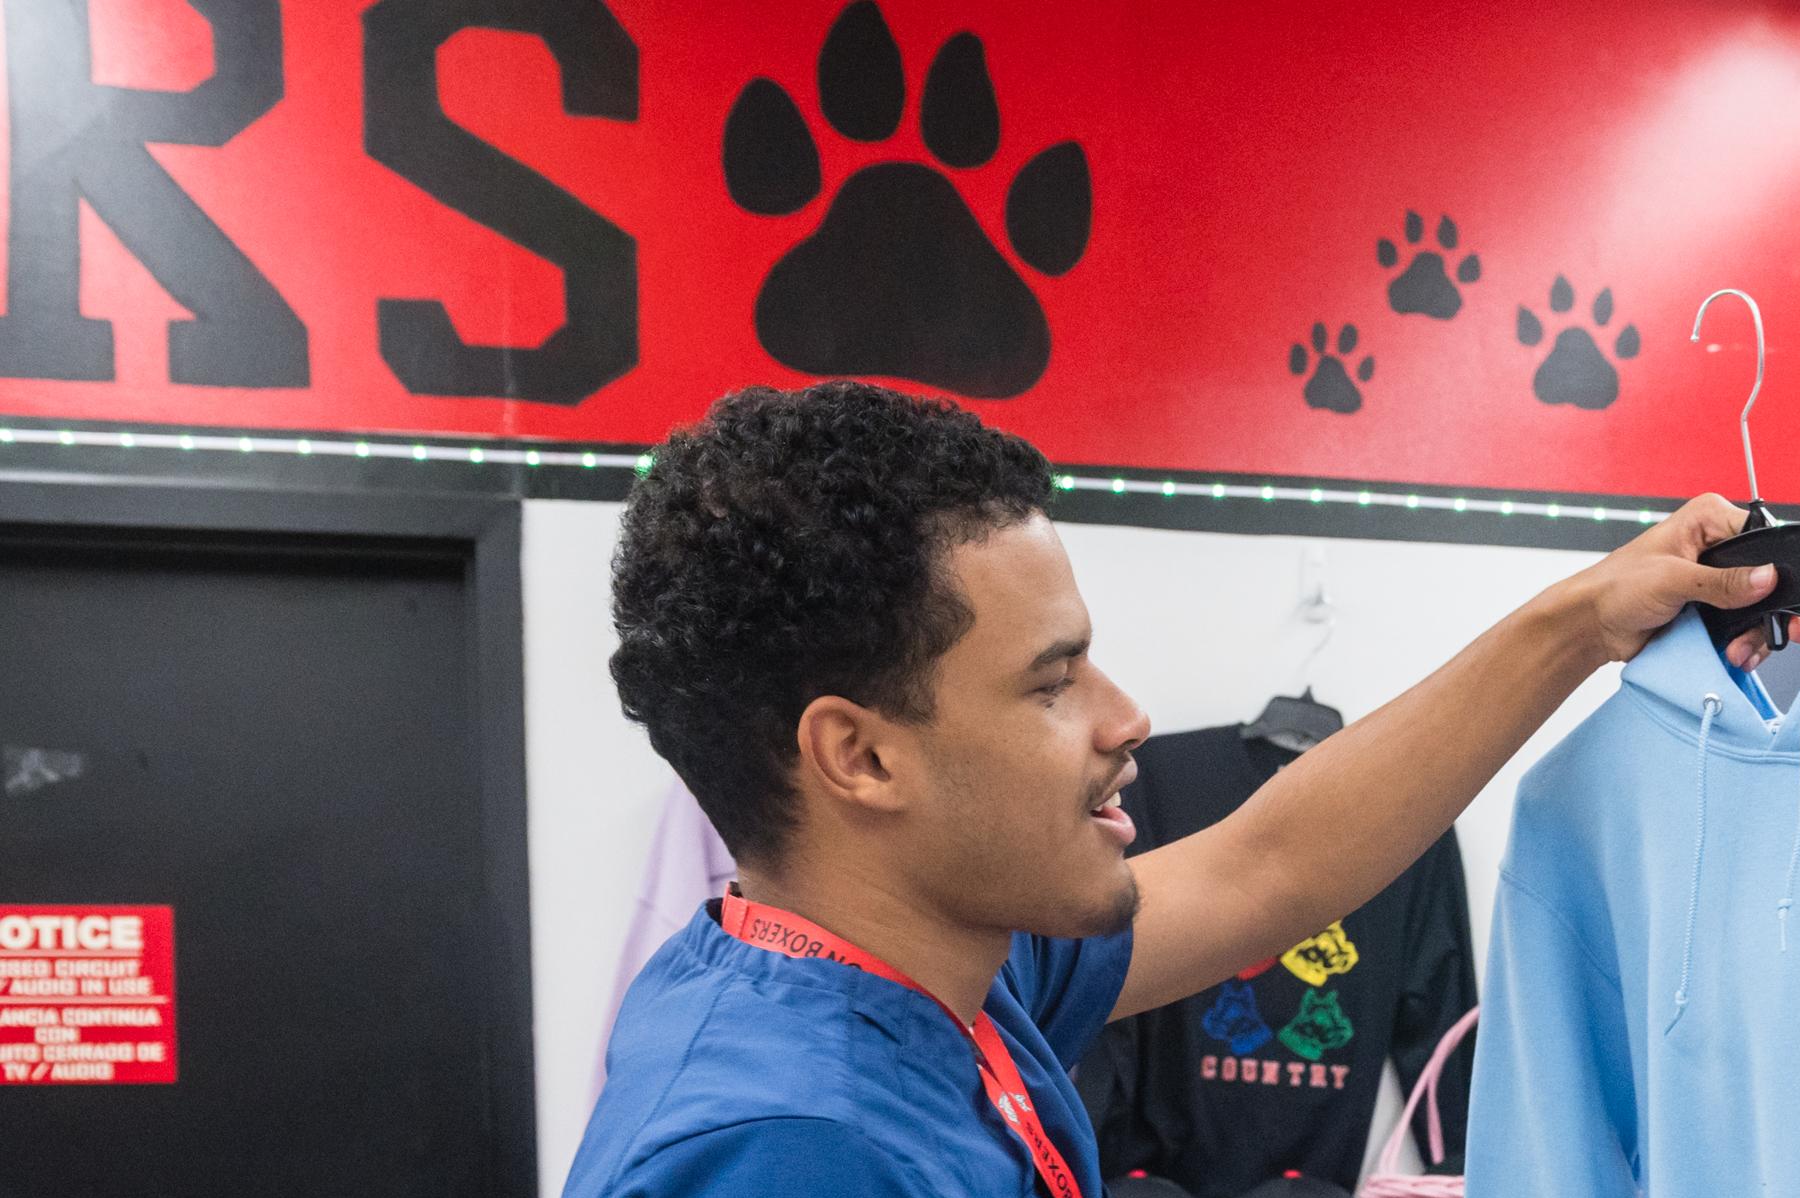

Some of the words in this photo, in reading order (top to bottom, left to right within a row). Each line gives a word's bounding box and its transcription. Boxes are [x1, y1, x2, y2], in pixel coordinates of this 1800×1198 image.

[751, 917, 825, 958] BOXERS
[54, 959, 140, 978] CIRCUIT
[80, 978, 105, 996] IN
[108, 977, 152, 997] USE
[61, 1007, 162, 1027] CONTINUA
[34, 1026, 80, 1043] CON
[43, 1042, 135, 1063] CERRADO
[137, 1042, 166, 1062] DE
[1201, 1054, 1350, 1090] COUNTRY
